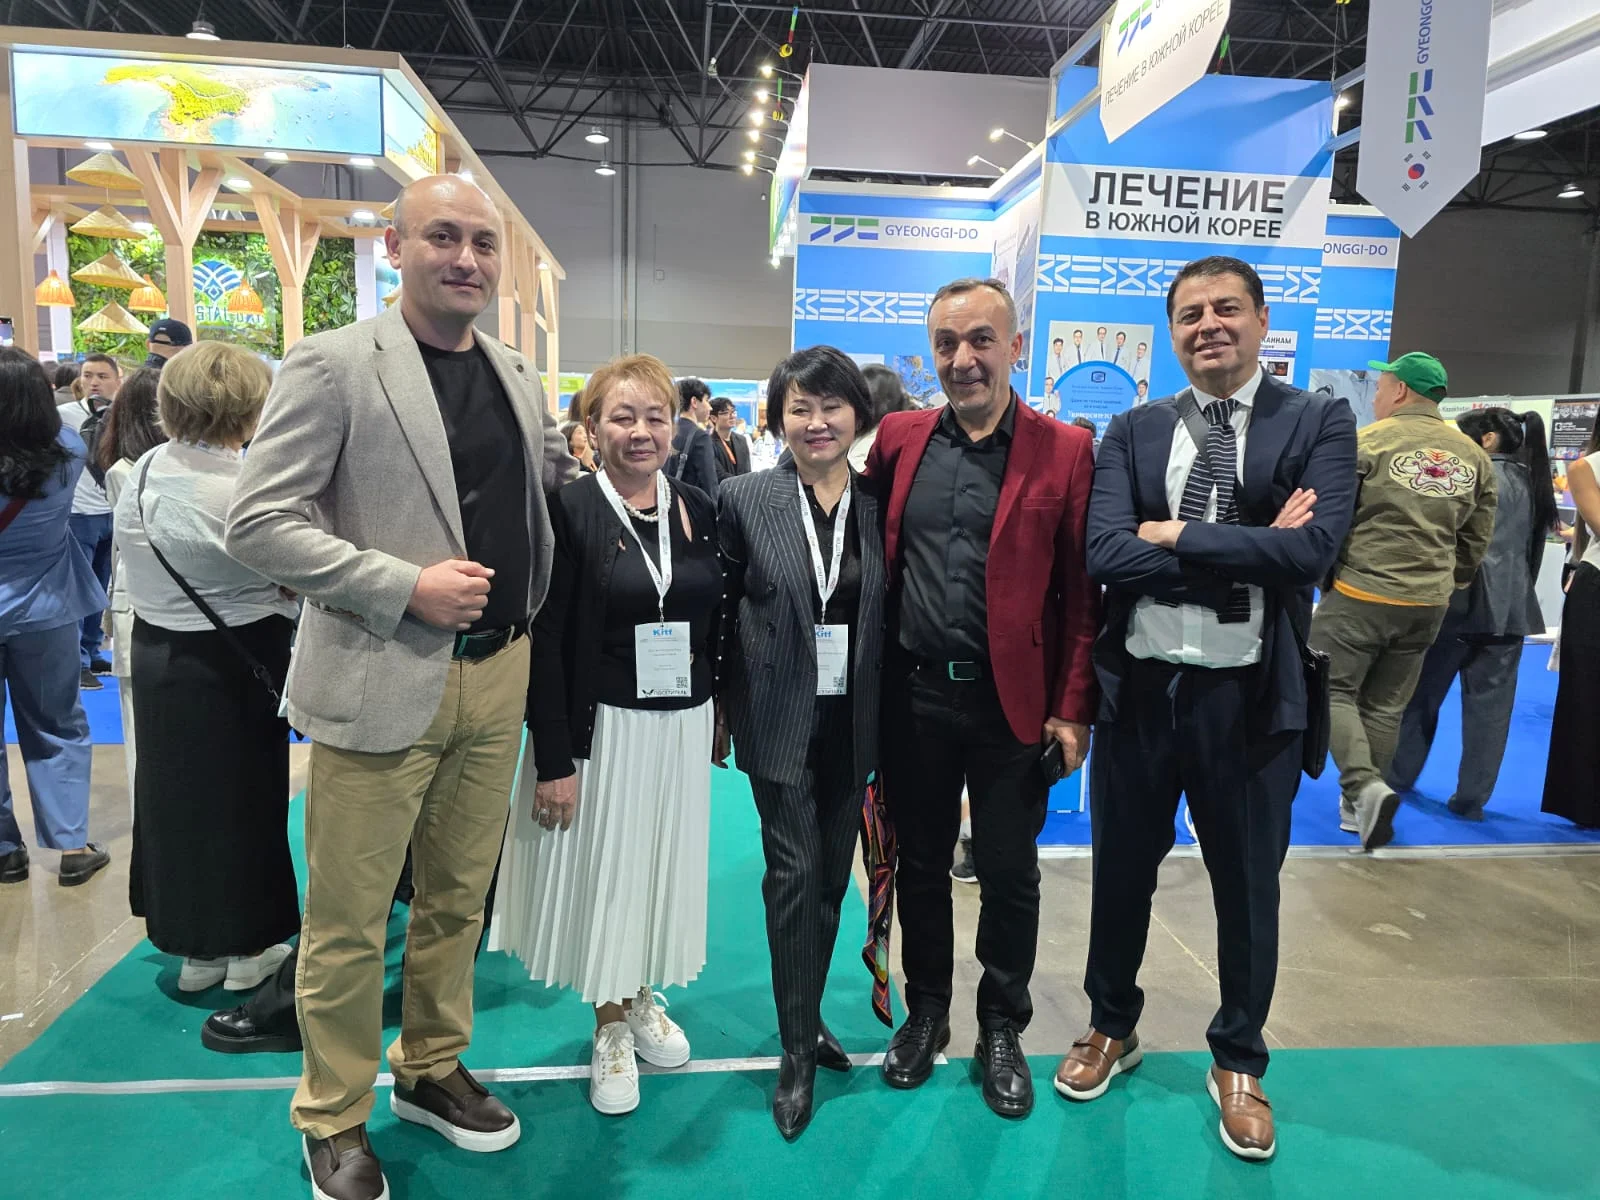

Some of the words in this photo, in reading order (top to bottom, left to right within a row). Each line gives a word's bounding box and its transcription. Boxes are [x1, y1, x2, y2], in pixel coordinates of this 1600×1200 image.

[1104, 65, 1140, 108] ЛЕЧЕНИЕ
[1140, 59, 1148, 77] В
[1148, 23, 1187, 71] ЮЖНОЙ
[1187, 0, 1225, 39] КОРЕЕ
[1088, 171, 1286, 214] ЛЕЧЕНИЕ
[885, 224, 979, 240] GYEONGGI-DO
[1085, 210, 1100, 229] В
[1108, 211, 1200, 234] ЮЖНОЙ
[1207, 217, 1282, 239] КОРЕЕ
[1323, 242, 1388, 256] ONGGI-DO
[652, 628, 673, 636] Kitf
